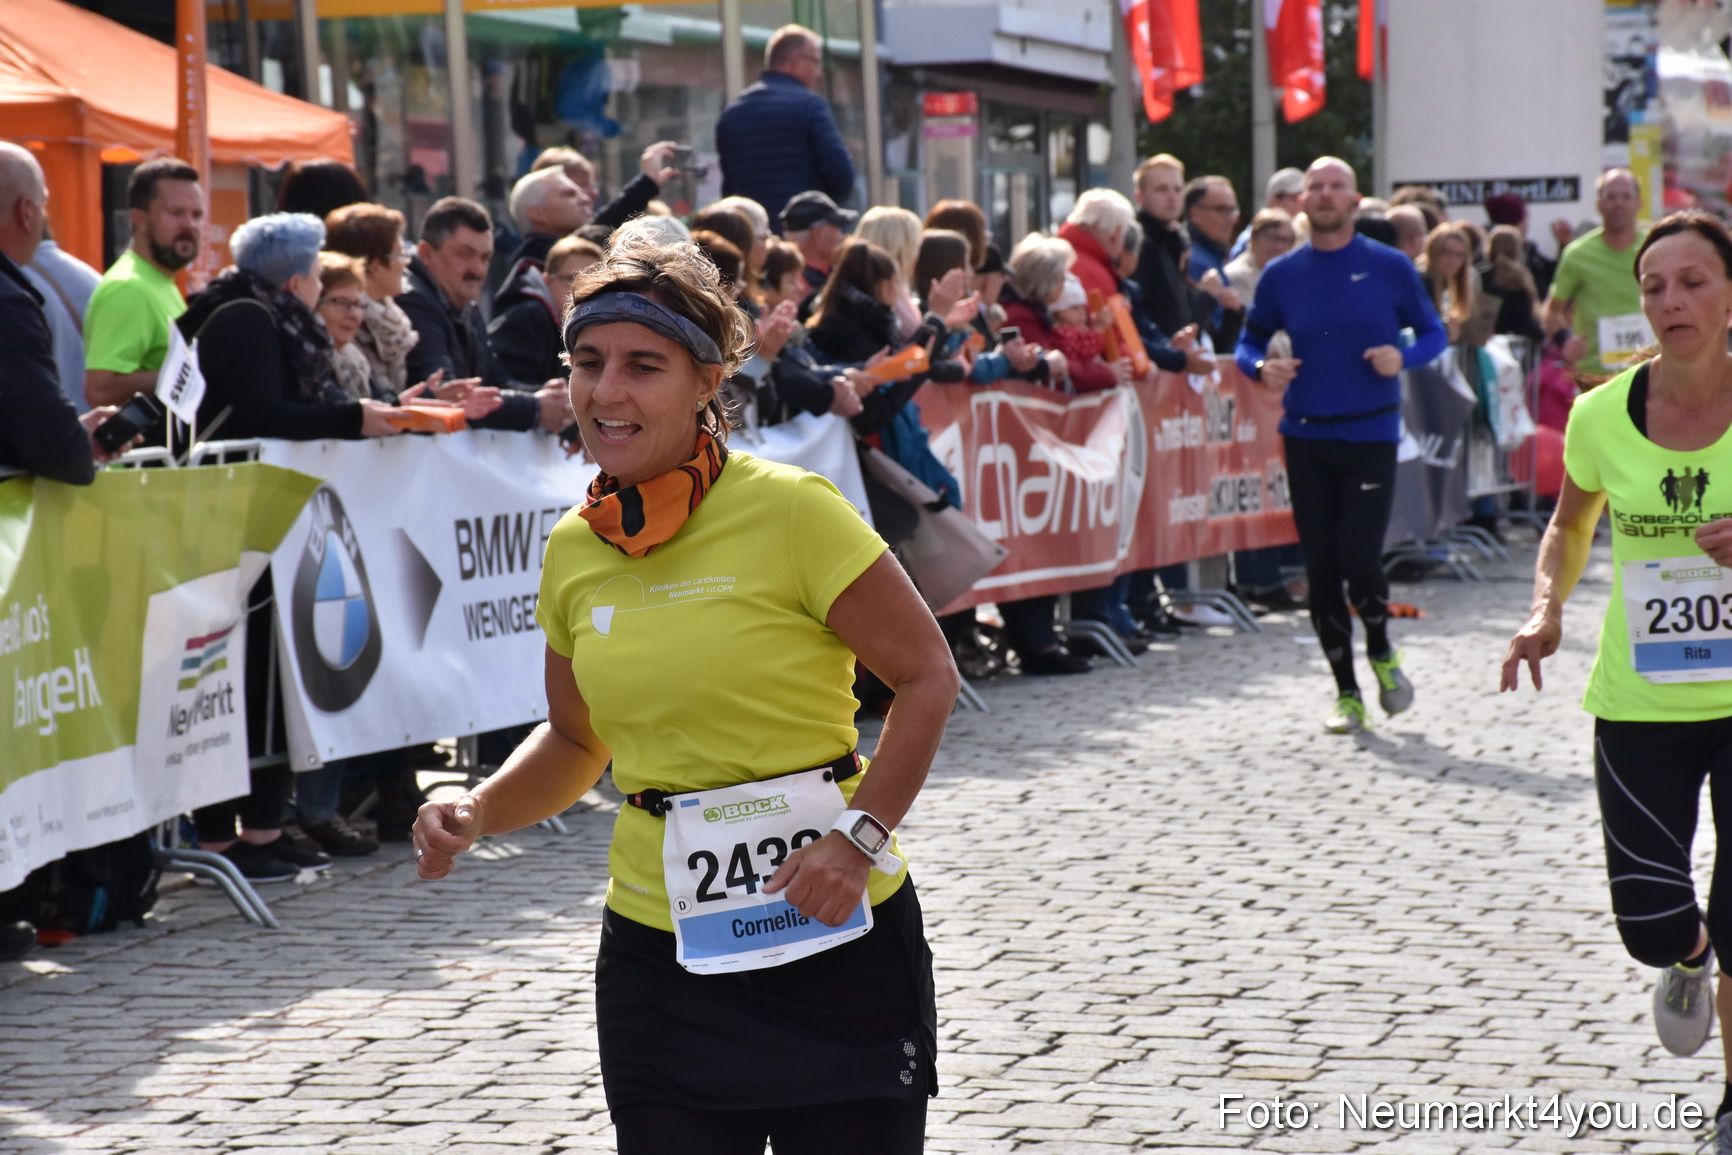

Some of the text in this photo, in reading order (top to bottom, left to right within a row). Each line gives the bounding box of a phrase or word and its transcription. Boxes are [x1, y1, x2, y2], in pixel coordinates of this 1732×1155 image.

[454, 510, 535, 581] BMW
[649, 575, 736, 593] Kliniken des Landkreises
[669, 587, 704, 599] Neumarkt
[463, 593, 542, 642] WENIGE
[1684, 647, 1711, 660] Rita
[722, 794, 790, 819] BOCK
[678, 900, 686, 911] D
[731, 906, 810, 939] Cornelia
